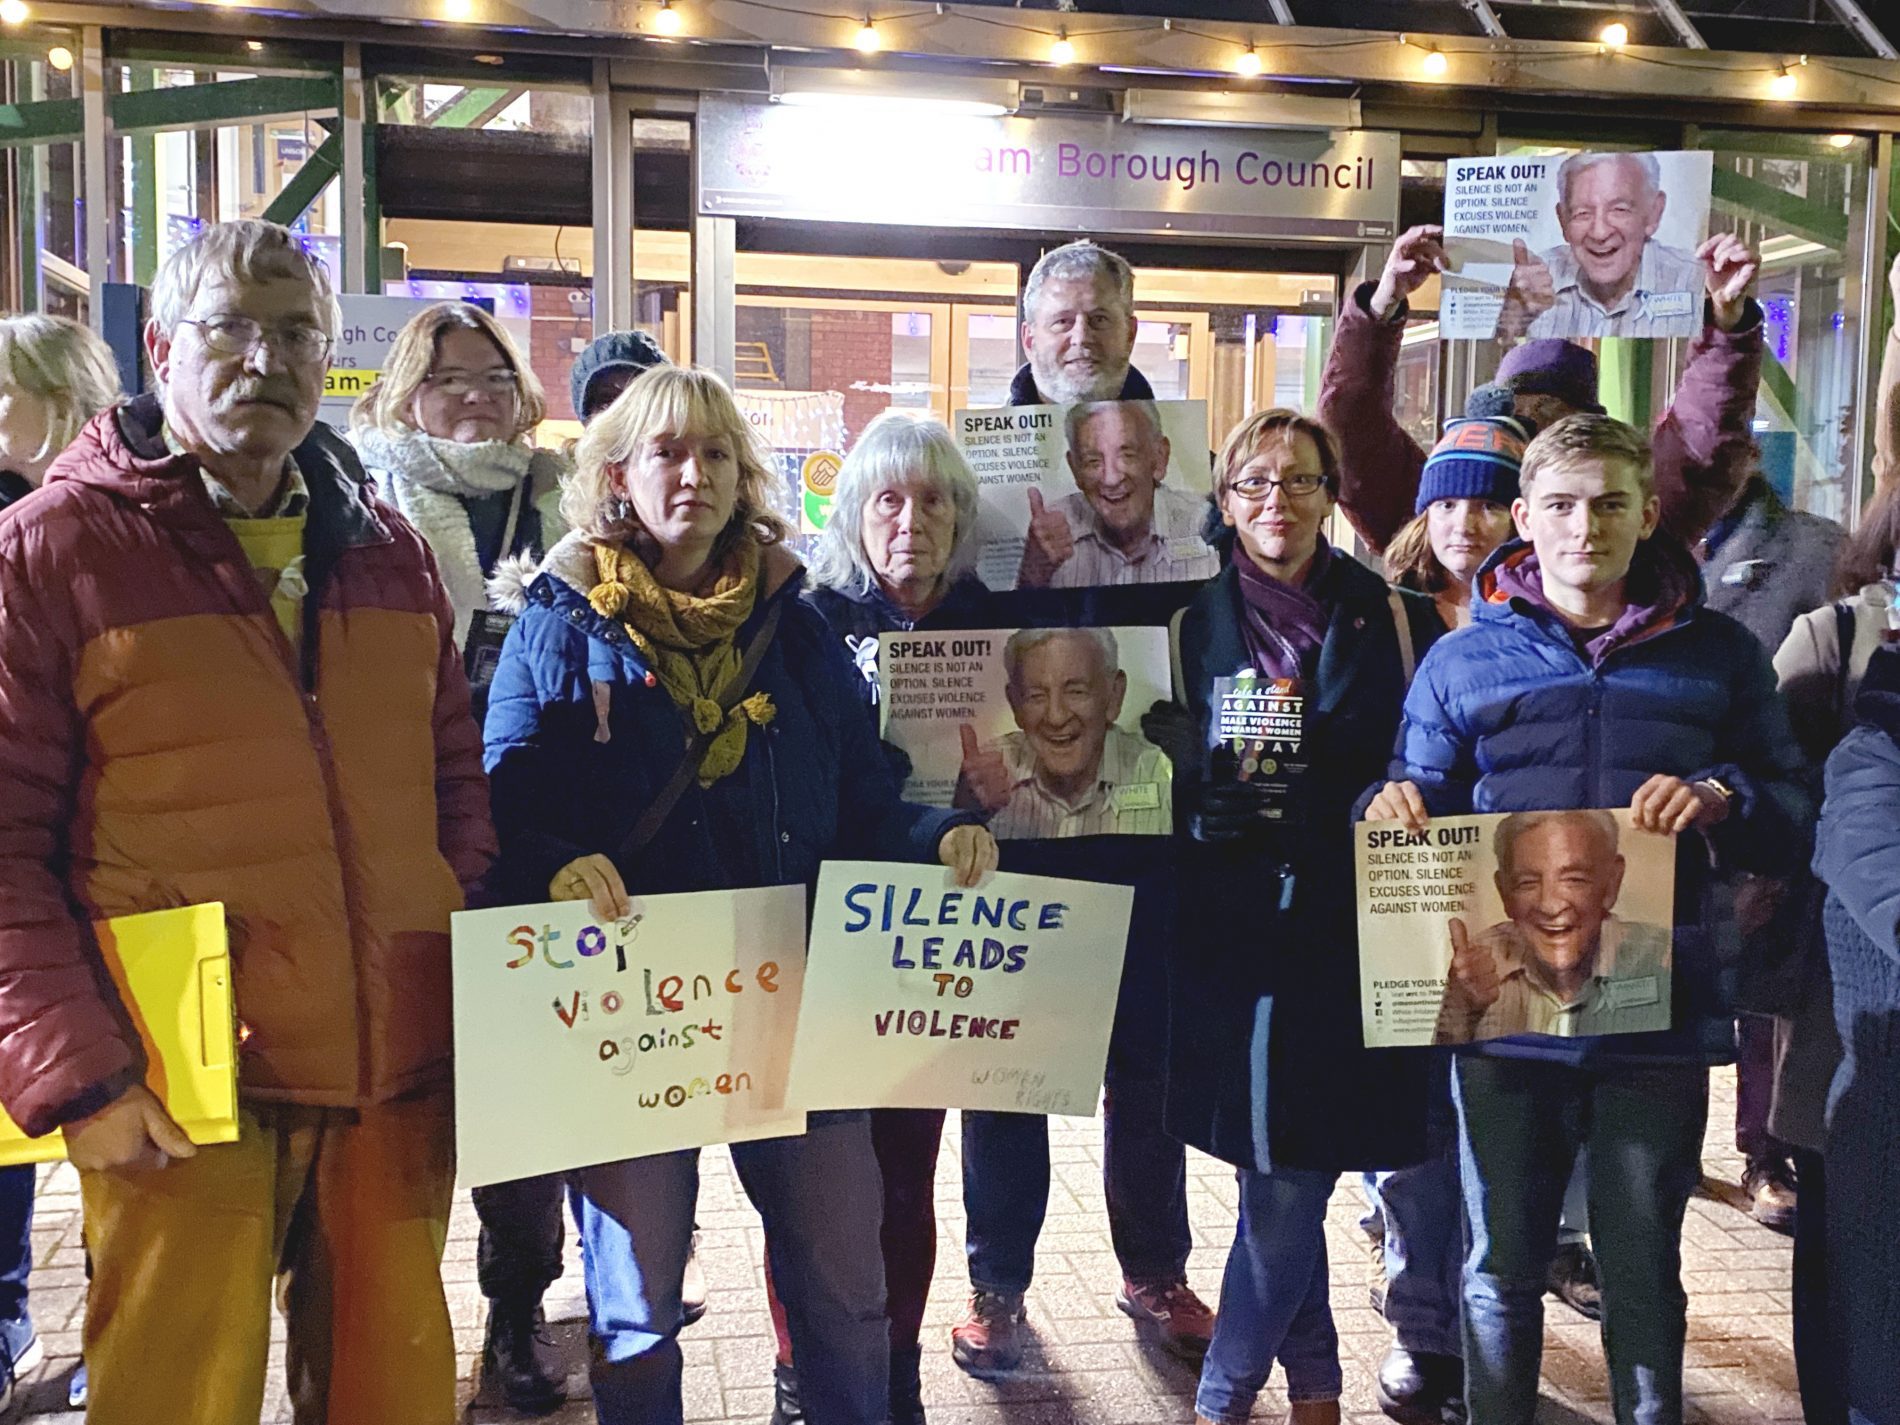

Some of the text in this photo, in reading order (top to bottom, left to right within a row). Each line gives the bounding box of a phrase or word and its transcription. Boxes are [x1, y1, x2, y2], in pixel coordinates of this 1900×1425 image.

[1058, 143, 1220, 190] Borough
[1236, 151, 1374, 190] Council
[1456, 164, 1546, 182] SPEAK OUT!
[1455, 183, 1537, 195] SILENCE IS NOT AN
[1455, 197, 1528, 208] OPTION. SILENCE
[1454, 210, 1538, 221] EXCUSES VIOLENCE
[1453, 223, 1530, 234] AGAINST WOMEN.
[964, 413, 1053, 432] SPEAK OUT!
[964, 432, 1046, 446] SILENCE IS NOT AN
[1002, 446, 1038, 457] SILENCE
[973, 459, 1049, 472] XCUSES VIOLENCE
[978, 474, 1005, 485] AINST
[889, 640, 991, 658] SPEAK OUT!
[889, 661, 983, 674] SILENCE IS NOT AN
[932, 677, 974, 688] SILENCE
[1256, 687, 1262, 695] a
[1265, 681, 1292, 695] stand
[890, 691, 986, 704] EXCUSES VIOLENCE
[890, 708, 933, 719] AGAINST
[1222, 700, 1303, 713] AGAINST
[1221, 716, 1302, 727] MALE VIOLENCE
[1221, 726, 1302, 736] TOWARDS WOMEN
[1220, 739, 1301, 753] TODAY
[1367, 826, 1480, 849] SPEAK OUT!
[1367, 850, 1472, 865] SILENCE IS NOT AN
[1368, 867, 1463, 882] OPTION. SILENCE
[1369, 882, 1475, 898] EXCUSES VIOLENCE
[844, 883, 1070, 932] SILENCE
[1369, 901, 1418, 914] AGAINST
[892, 936, 1029, 973] LEADS
[933, 973, 973, 998] TO
[1373, 980, 1410, 989] PLEDGE
[874, 1009, 1020, 1040] VIOLENCE
[599, 1018, 722, 1077] against
[971, 1066, 1046, 1087] WOMEN
[638, 1072, 752, 1108] women
